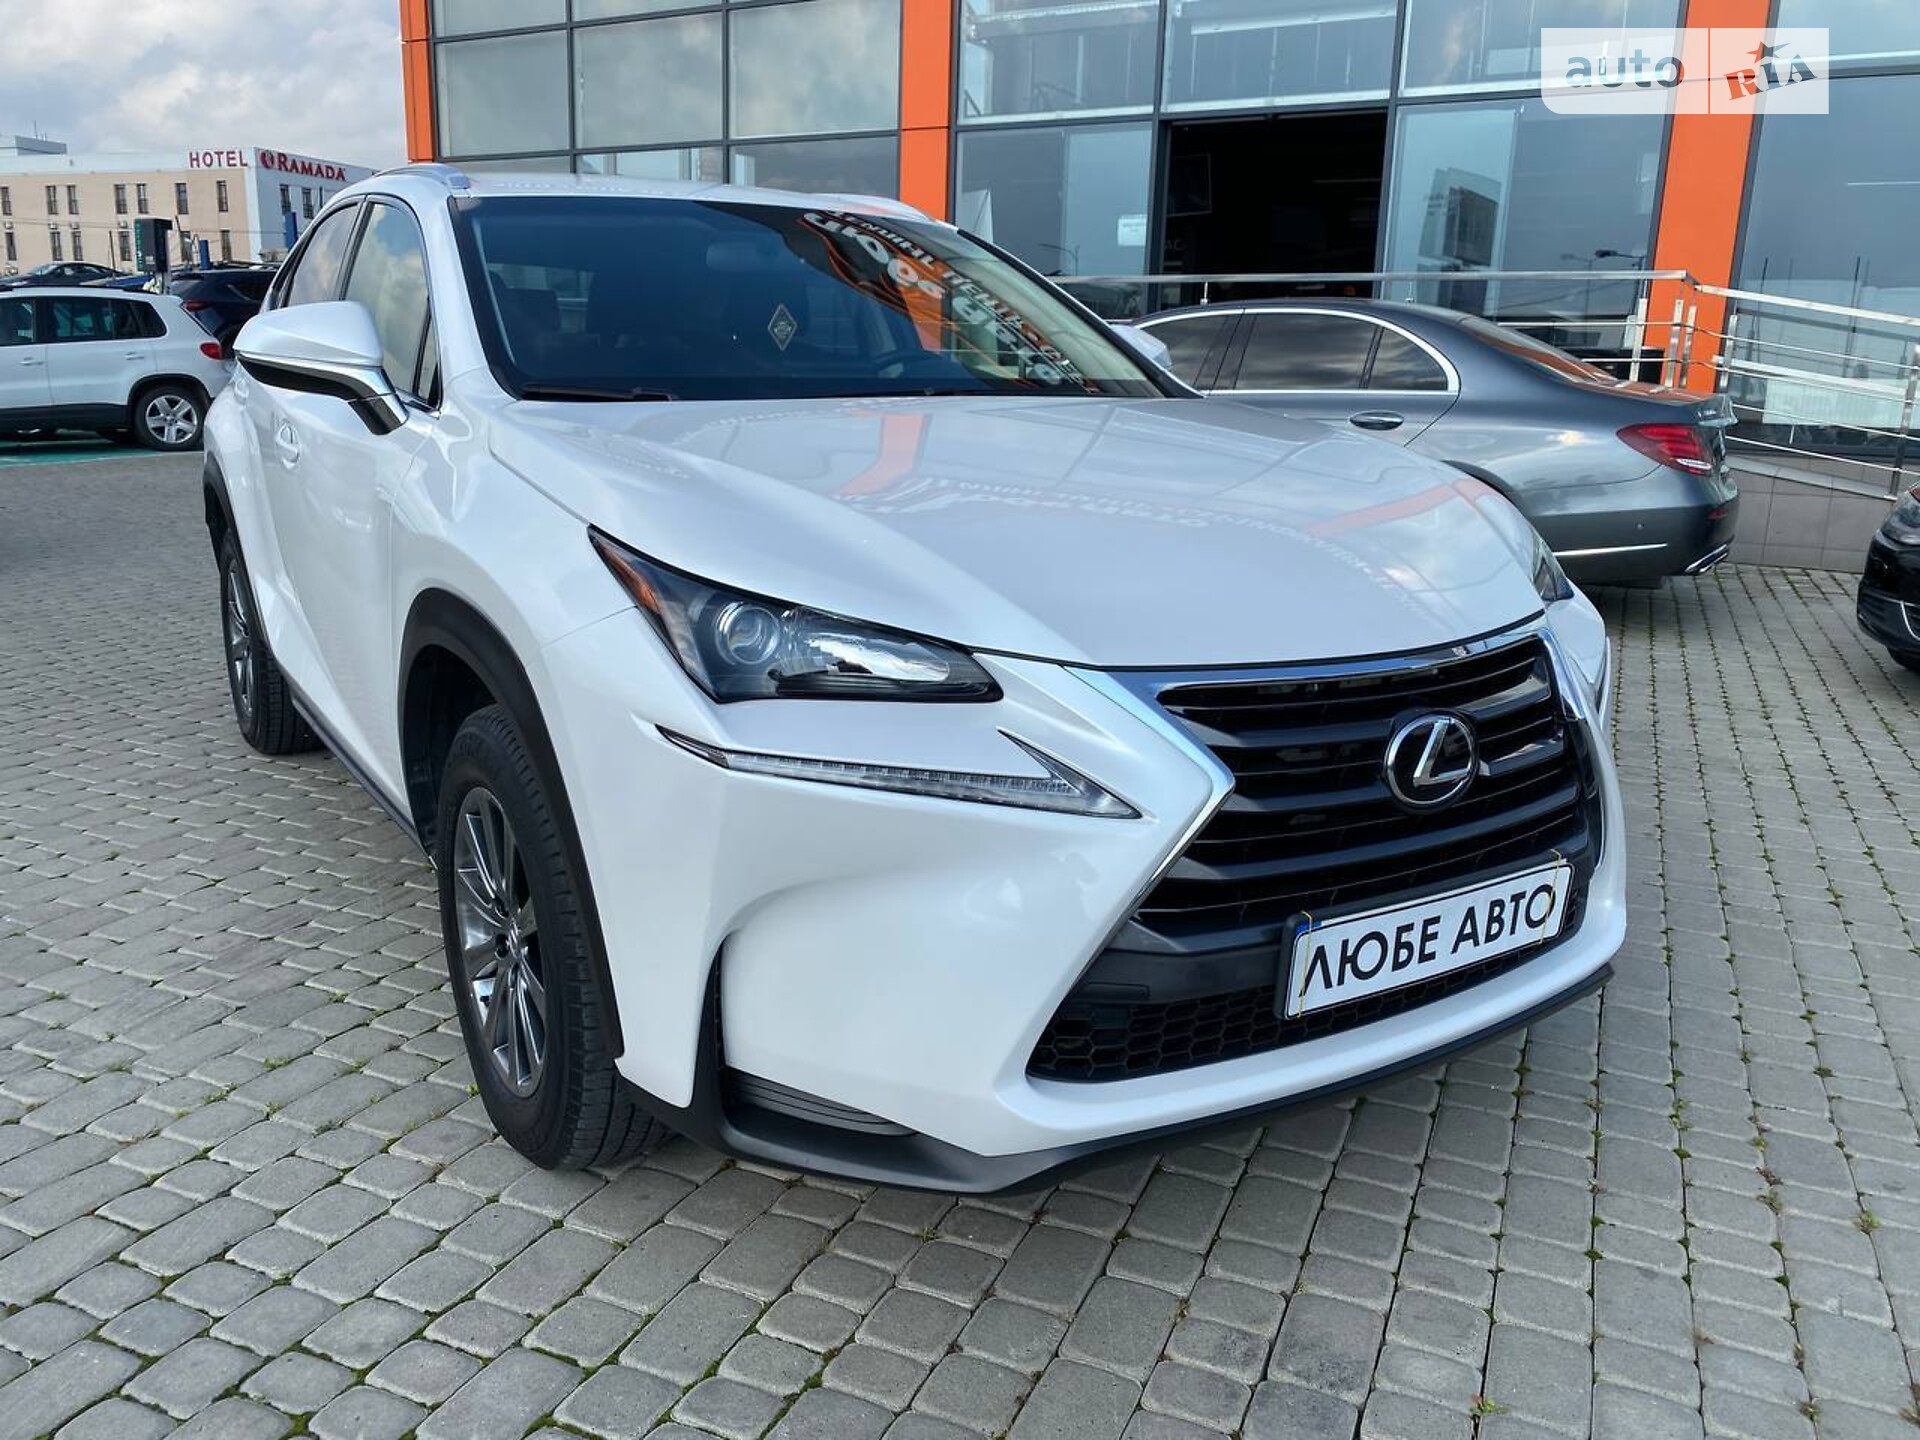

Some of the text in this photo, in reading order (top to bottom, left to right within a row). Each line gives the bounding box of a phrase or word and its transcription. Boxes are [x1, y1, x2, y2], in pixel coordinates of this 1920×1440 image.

[189, 150, 248, 169] HOTEL
[277, 152, 347, 182] RAMADA
[1298, 884, 1556, 998] ЛЮБЕ АВТО
